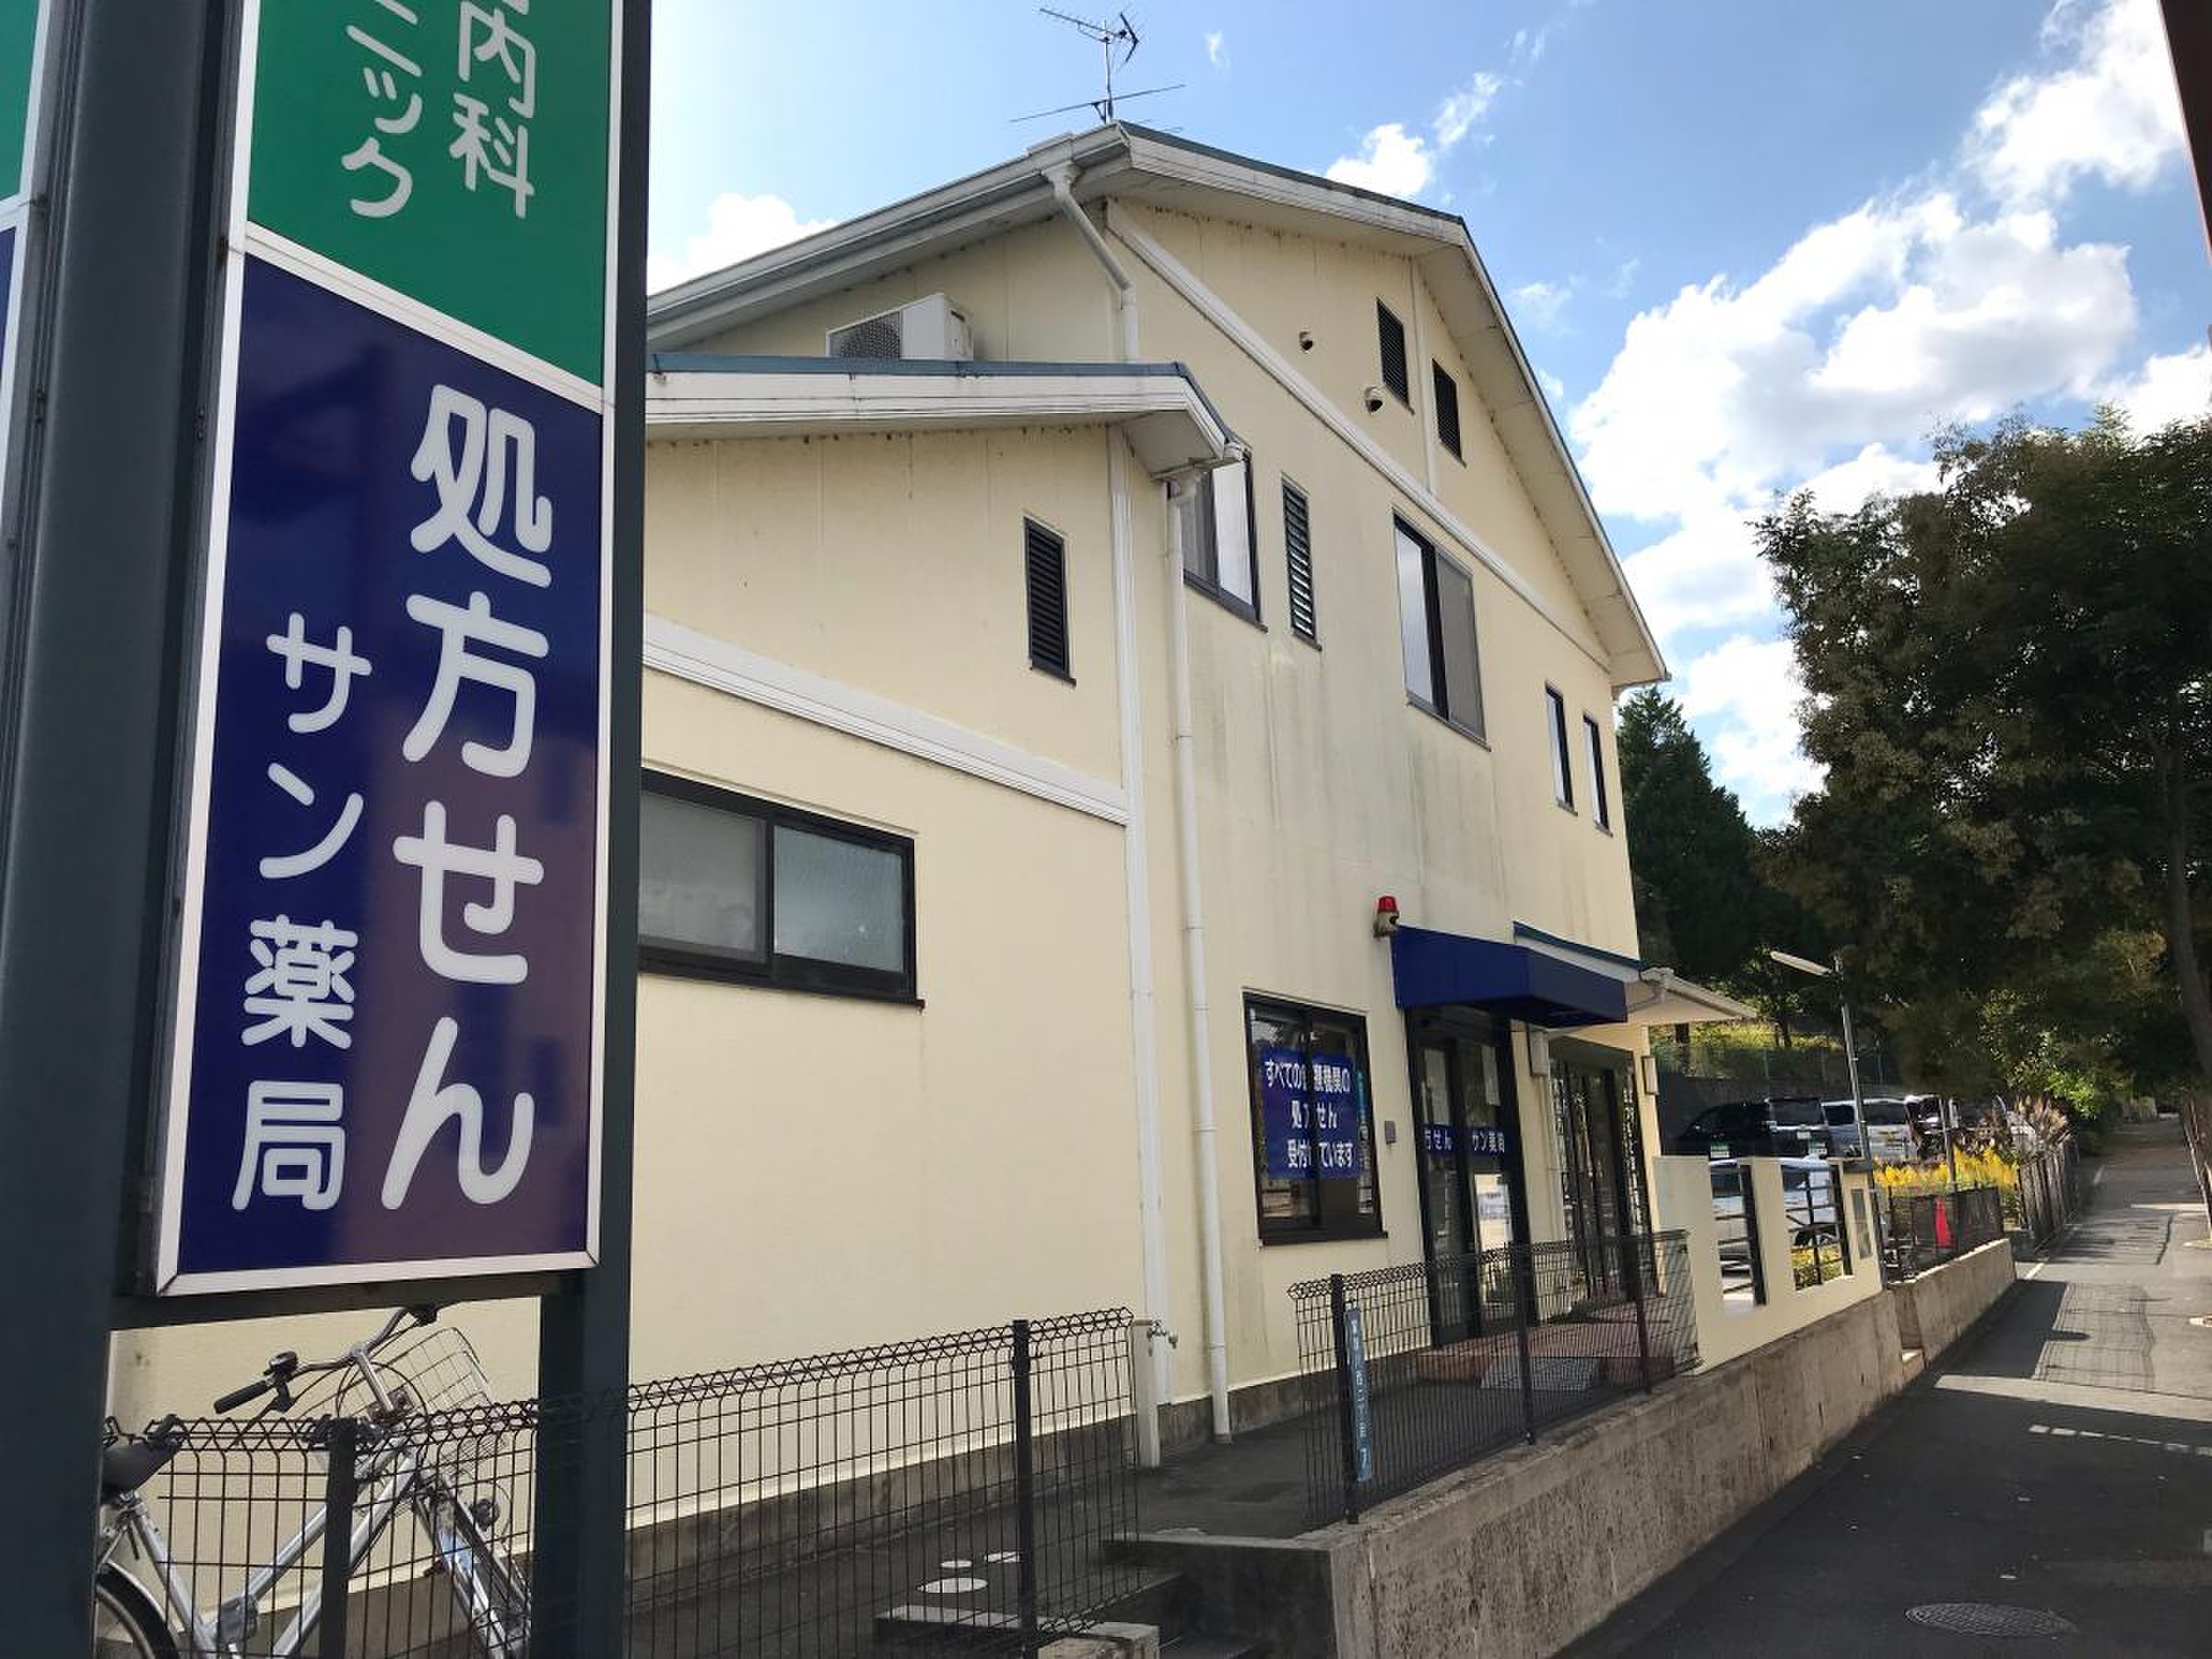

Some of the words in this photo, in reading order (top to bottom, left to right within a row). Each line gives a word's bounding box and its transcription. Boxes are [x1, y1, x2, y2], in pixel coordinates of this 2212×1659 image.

[341, 0, 423, 218] ニック
[449, 0, 535, 218] 内科
[231, 612, 372, 1210] サン薬局
[381, 383, 552, 1210] 処方せん
